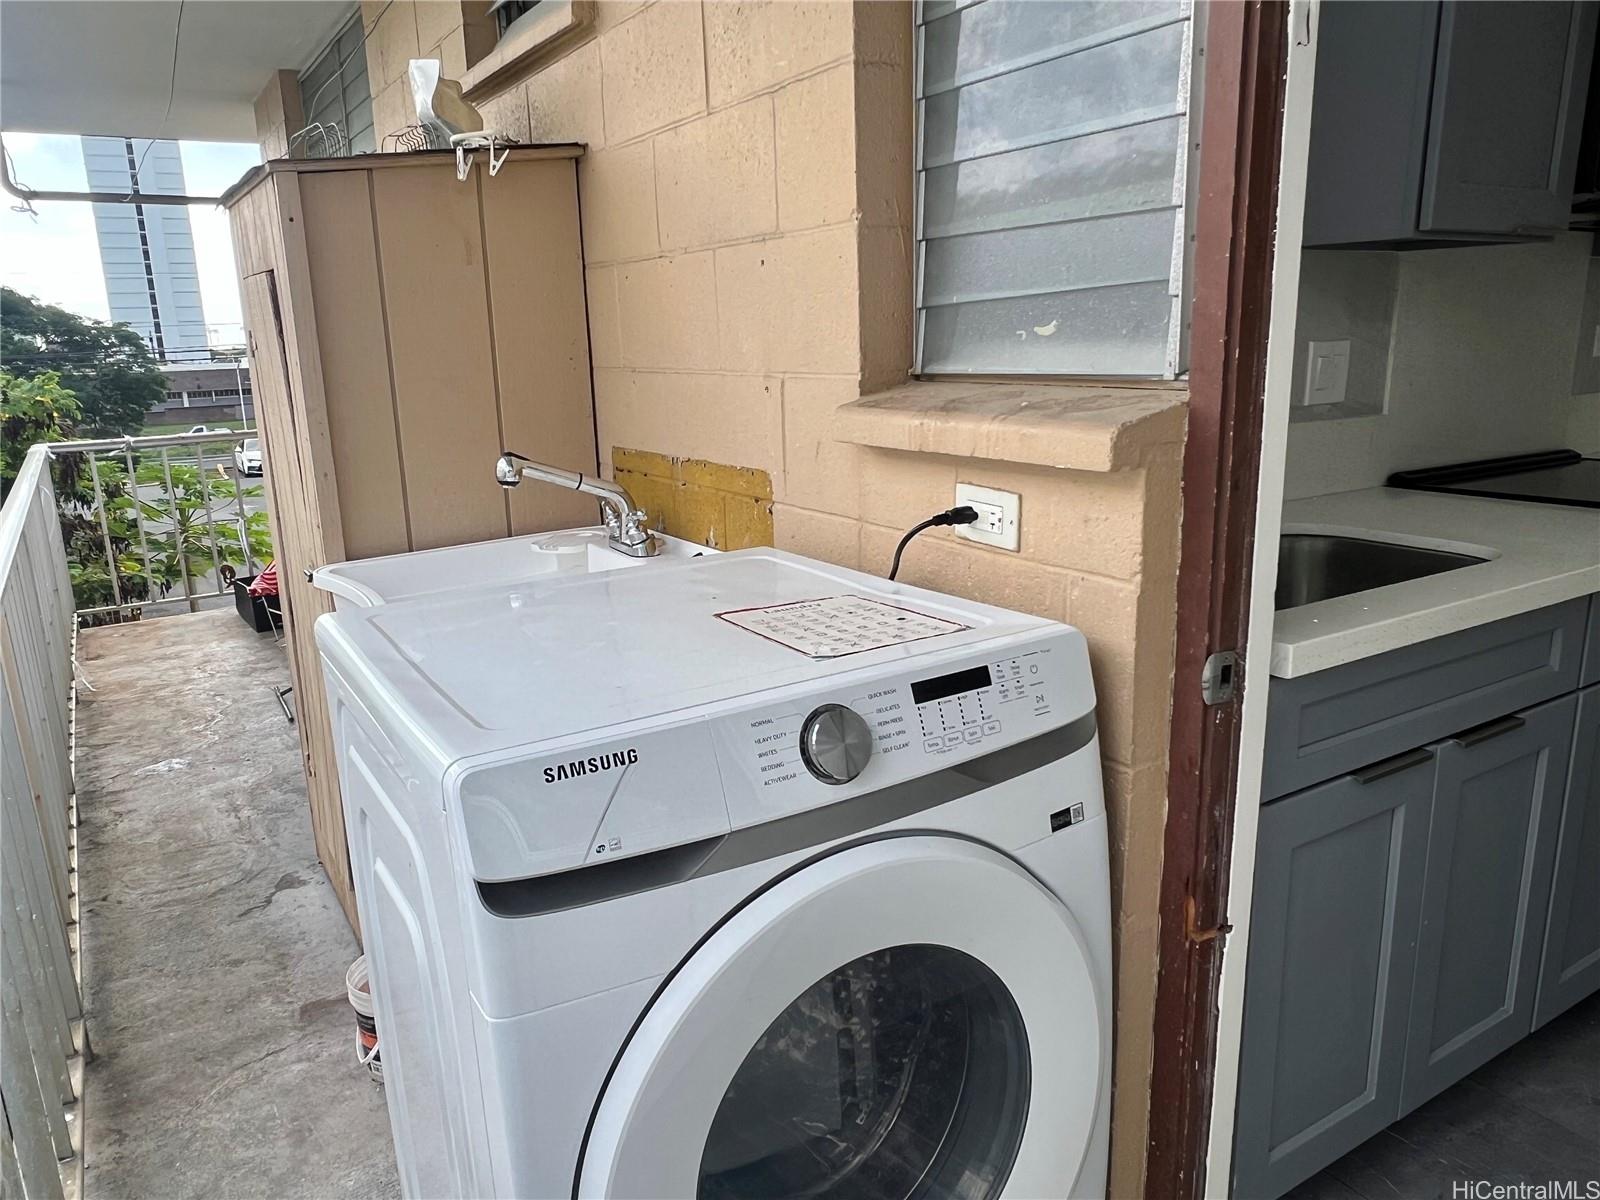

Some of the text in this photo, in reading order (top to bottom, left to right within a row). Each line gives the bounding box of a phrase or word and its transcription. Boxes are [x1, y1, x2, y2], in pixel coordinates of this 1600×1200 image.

[867, 688, 897, 700] QUICK WASH
[875, 703, 901, 714] DELICATES
[750, 718, 775, 728] NORMAL
[889, 715, 904, 723] PRESS
[754, 731, 788, 745] HEAVY DUTY
[878, 733, 892, 741] RINSE
[757, 748, 779, 759] WHITES
[543, 748, 639, 784] SAMSUNG
[760, 761, 785, 773] BEDDING
[764, 772, 798, 786] ACTIVEWEAR
